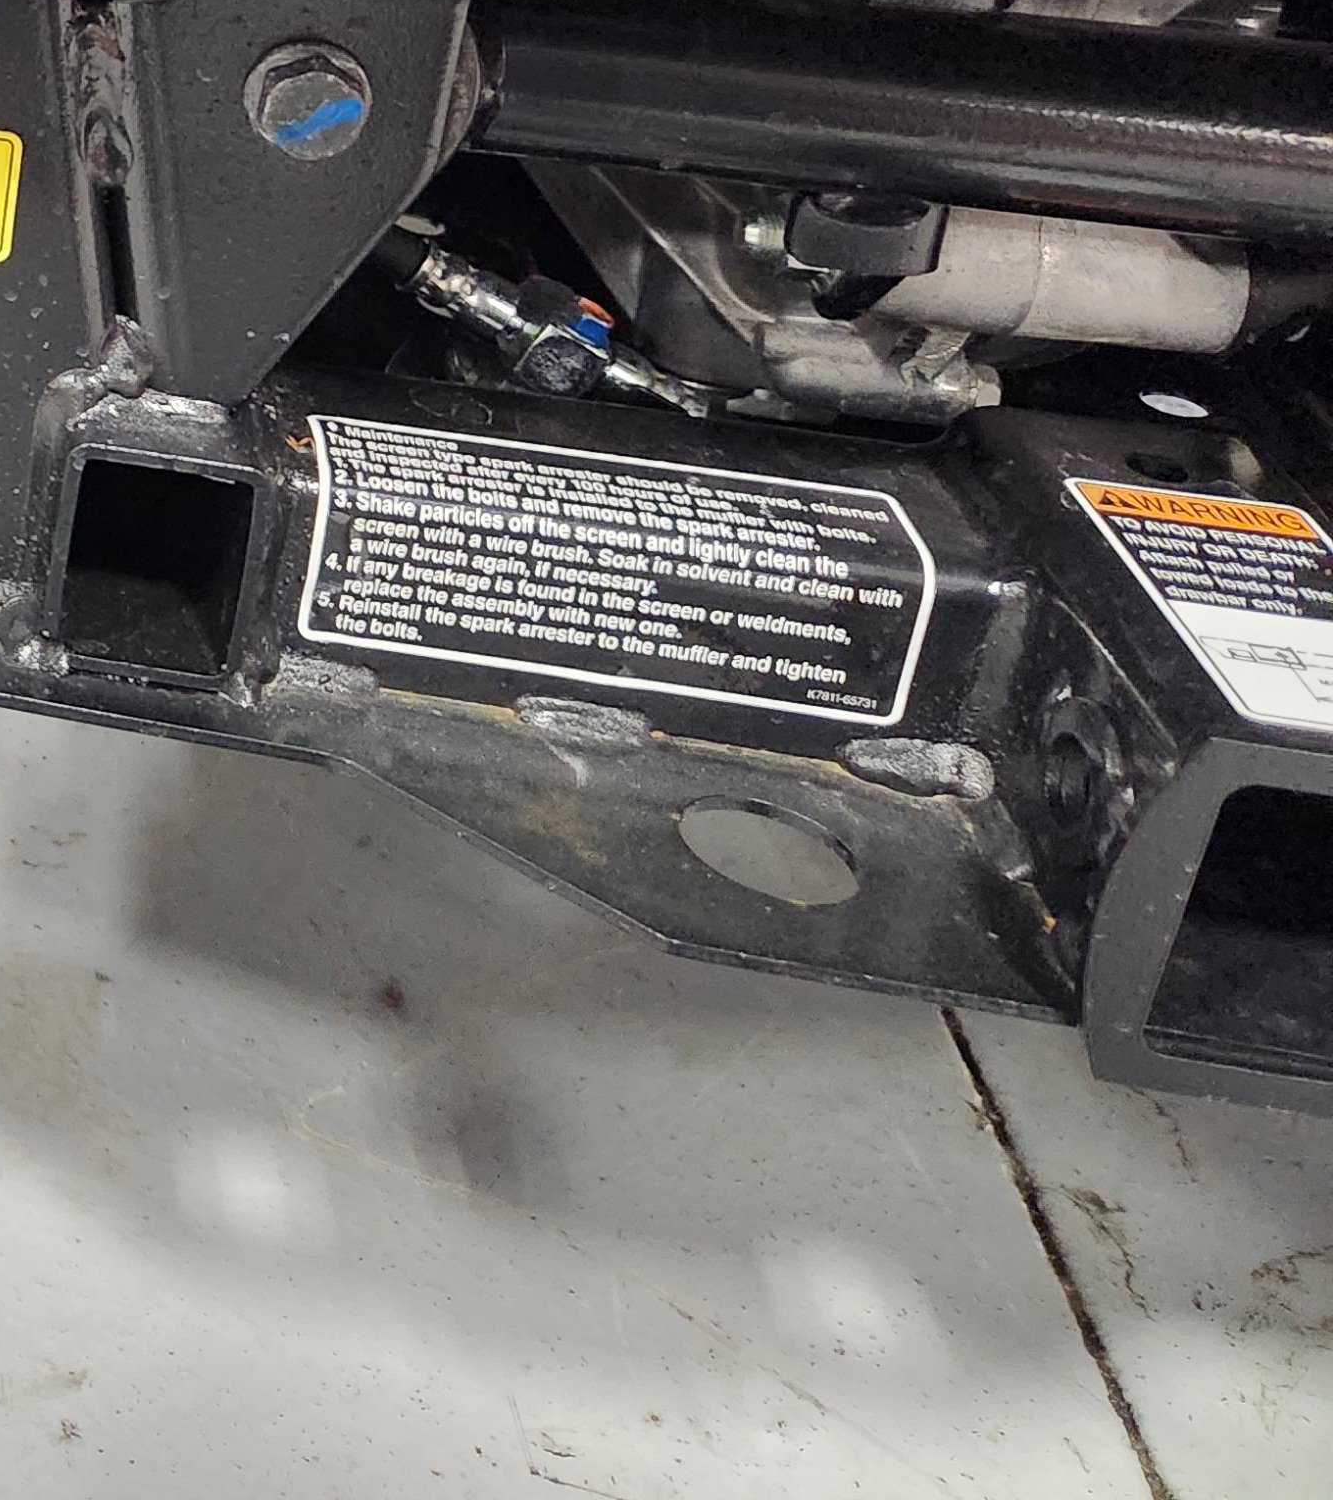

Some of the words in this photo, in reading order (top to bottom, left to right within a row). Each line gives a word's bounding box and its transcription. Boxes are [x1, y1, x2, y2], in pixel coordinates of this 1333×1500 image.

[344, 426, 459, 451] Maintenance
[326, 431, 363, 448] The
[365, 440, 430, 458] screen
[433, 448, 476, 465] type
[479, 456, 535, 473] spark
[537, 465, 611, 483] arrester
[615, 475, 685, 494] should
[684, 484, 713, 498] be
[810, 502, 890, 523] cleaned
[329, 446, 366, 460] and
[369, 451, 463, 474] inspected
[466, 465, 510, 480] after
[513, 472, 566, 489] every
[570, 479, 607, 493] 100
[608, 484, 669, 502] hours
[669, 493, 692, 506] of
[694, 497, 740, 512] use.
[333, 457, 349, 469] 1.
[348, 459, 387, 474] The
[389, 465, 445, 483] spark
[448, 476, 522, 494] arrester
[526, 483, 546, 496] is
[548, 486, 634, 509] installed
[634, 499, 658, 512] to
[658, 502, 694, 518] the
[695, 508, 766, 527] muffler
[769, 518, 815, 535] with
[816, 523, 877, 544] bolts.
[334, 469, 353, 486] 2.
[356, 470, 429, 497] Loosen
[431, 482, 464, 502] the
[467, 487, 518, 510] bolts
[521, 496, 560, 515] and
[563, 502, 637, 526] remove
[638, 511, 674, 531] the
[675, 517, 734, 540] spark
[736, 526, 821, 552] arrester.
[334, 488, 353, 510] 3.
[356, 491, 416, 518] Shake
[419, 503, 504, 530] particles
[508, 513, 535, 534] off
[539, 517, 571, 540] the
[574, 526, 642, 550] screen
[645, 535, 685, 556] and
[689, 536, 751, 568] lightly
[755, 547, 811, 574] clean
[814, 555, 849, 579] the
[1108, 515, 1140, 531] TO
[1143, 521, 1208, 541] AVOID
[1206, 529, 1327, 556] PERSONAL
[1128, 493, 1309, 533] WARNING
[349, 537, 363, 553] a
[366, 538, 408, 558] wire
[411, 544, 468, 567] brush
[471, 553, 531, 578] again,
[534, 561, 552, 579] if
[552, 565, 658, 597] necessary.
[352, 516, 420, 540] screen
[423, 526, 466, 546] with
[467, 533, 483, 549] a
[485, 534, 528, 556] wire
[597, 548, 649, 572] Soak
[652, 556, 673, 575] in
[675, 563, 755, 590] solvent
[754, 573, 796, 594] and
[798, 578, 854, 601] clean
[858, 587, 904, 609] with
[1122, 532, 1198, 554] INJURY
[1202, 544, 1239, 560] OR
[1237, 547, 1319, 570] DEATH:
[1138, 550, 1205, 571] Attach
[1206, 560, 1271, 580] pulled
[1272, 570, 1295, 583] or
[324, 552, 343, 572] 4.
[345, 555, 361, 575] If
[362, 559, 400, 581] any
[402, 562, 491, 593] breakage
[494, 577, 514, 595] is
[517, 579, 576, 605] found
[578, 587, 599, 606] in
[602, 591, 636, 612] the
[638, 599, 707, 623] screen
[709, 609, 735, 625] or
[737, 611, 852, 645] weldments,
[342, 578, 414, 598] replace
[416, 584, 449, 605] the
[451, 592, 545, 623] assembly
[548, 605, 591, 625] with
[594, 612, 637, 633] new
[638, 620, 683, 639] one.
[1149, 567, 1215, 588] towed
[1214, 575, 1274, 595] loads
[1273, 583, 1299, 600] to
[1297, 588, 1333, 603] the
[1164, 585, 1247, 608] drawbar
[1250, 598, 1303, 616] only.
[317, 591, 335, 609] 5.
[338, 594, 423, 621] Reinstall
[424, 606, 457, 627] the
[459, 613, 516, 634] spark
[517, 622, 596, 646] arrester
[597, 631, 620, 650] to
[621, 636, 656, 656] the
[657, 642, 730, 667] muffler
[730, 653, 772, 674] and
[774, 658, 847, 685] tighten
[335, 613, 367, 634] the
[369, 618, 423, 641] bolts.
